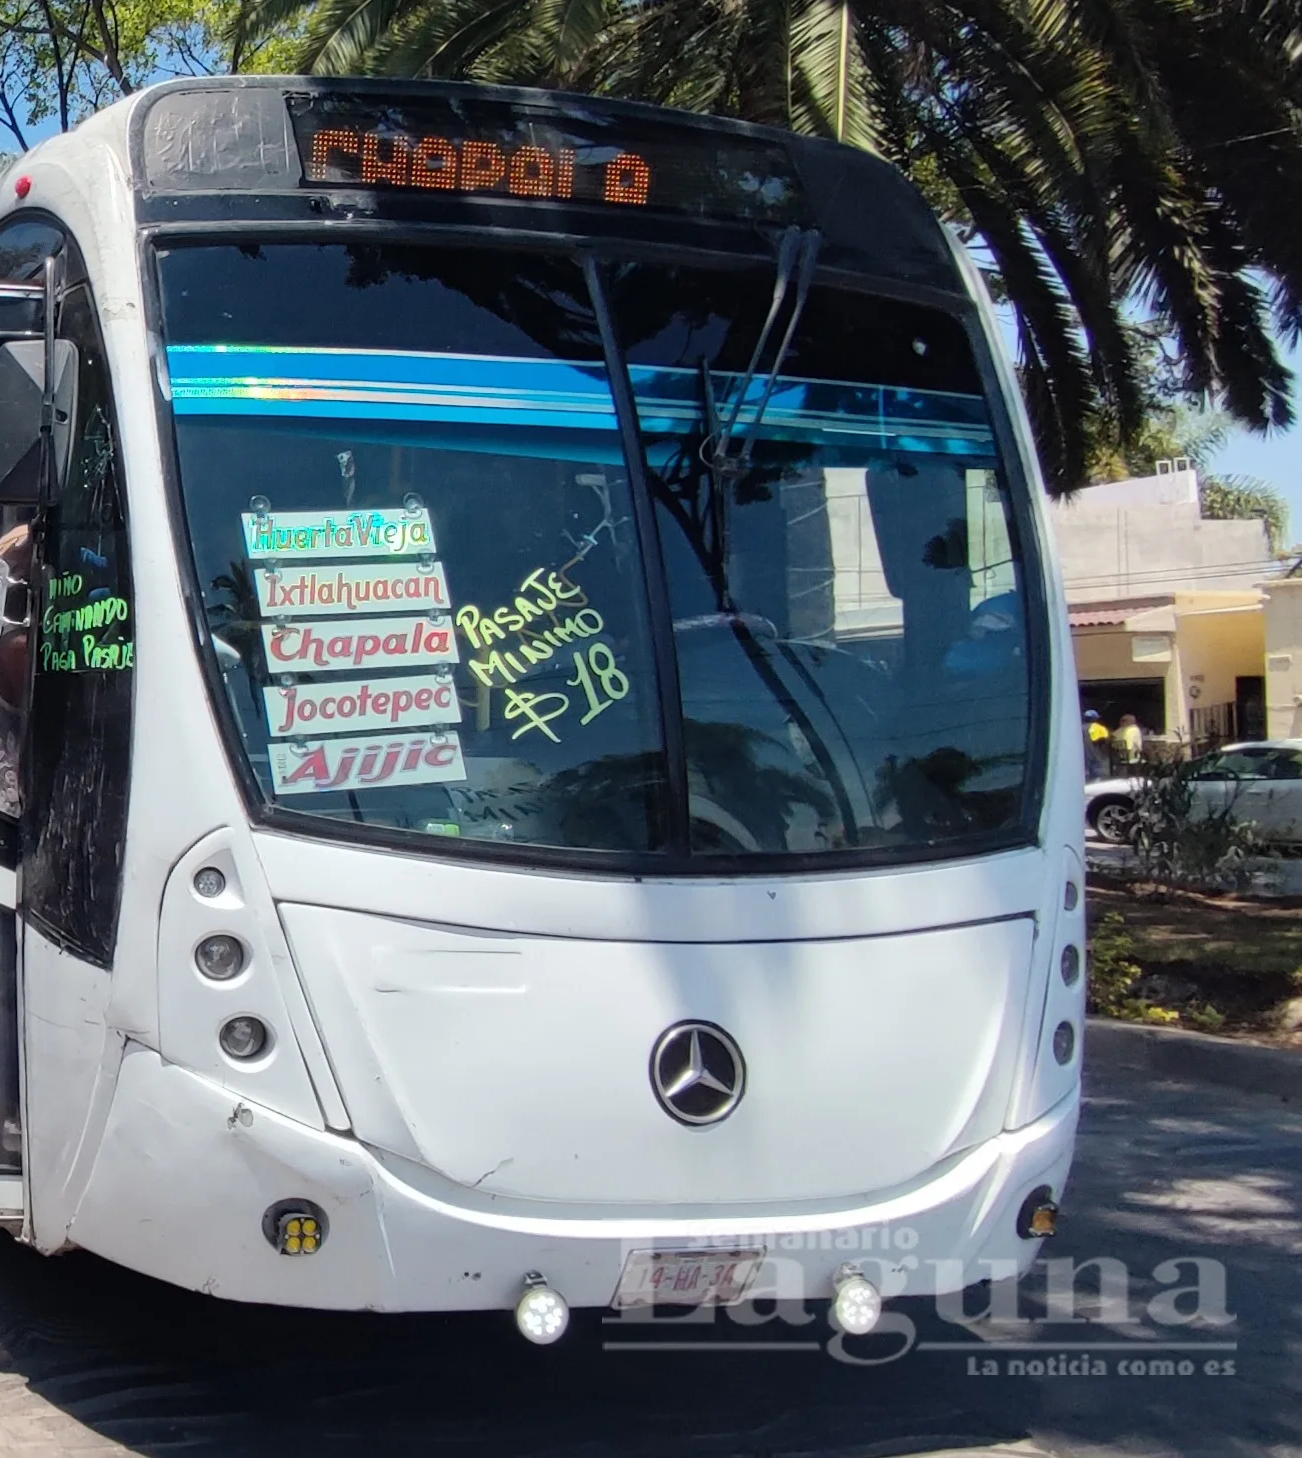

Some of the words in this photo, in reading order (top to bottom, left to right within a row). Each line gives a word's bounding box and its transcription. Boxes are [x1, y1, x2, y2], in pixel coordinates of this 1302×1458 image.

[266, 572, 445, 611] Ixtlahuacan
[455, 567, 581, 649] PASAJE
[82, 634, 134, 670] PASAJE
[270, 622, 450, 667] Chapala
[468, 608, 604, 687] MINIMO
[277, 684, 452, 733] Jocotepec
[281, 738, 458, 789] Ajijic
